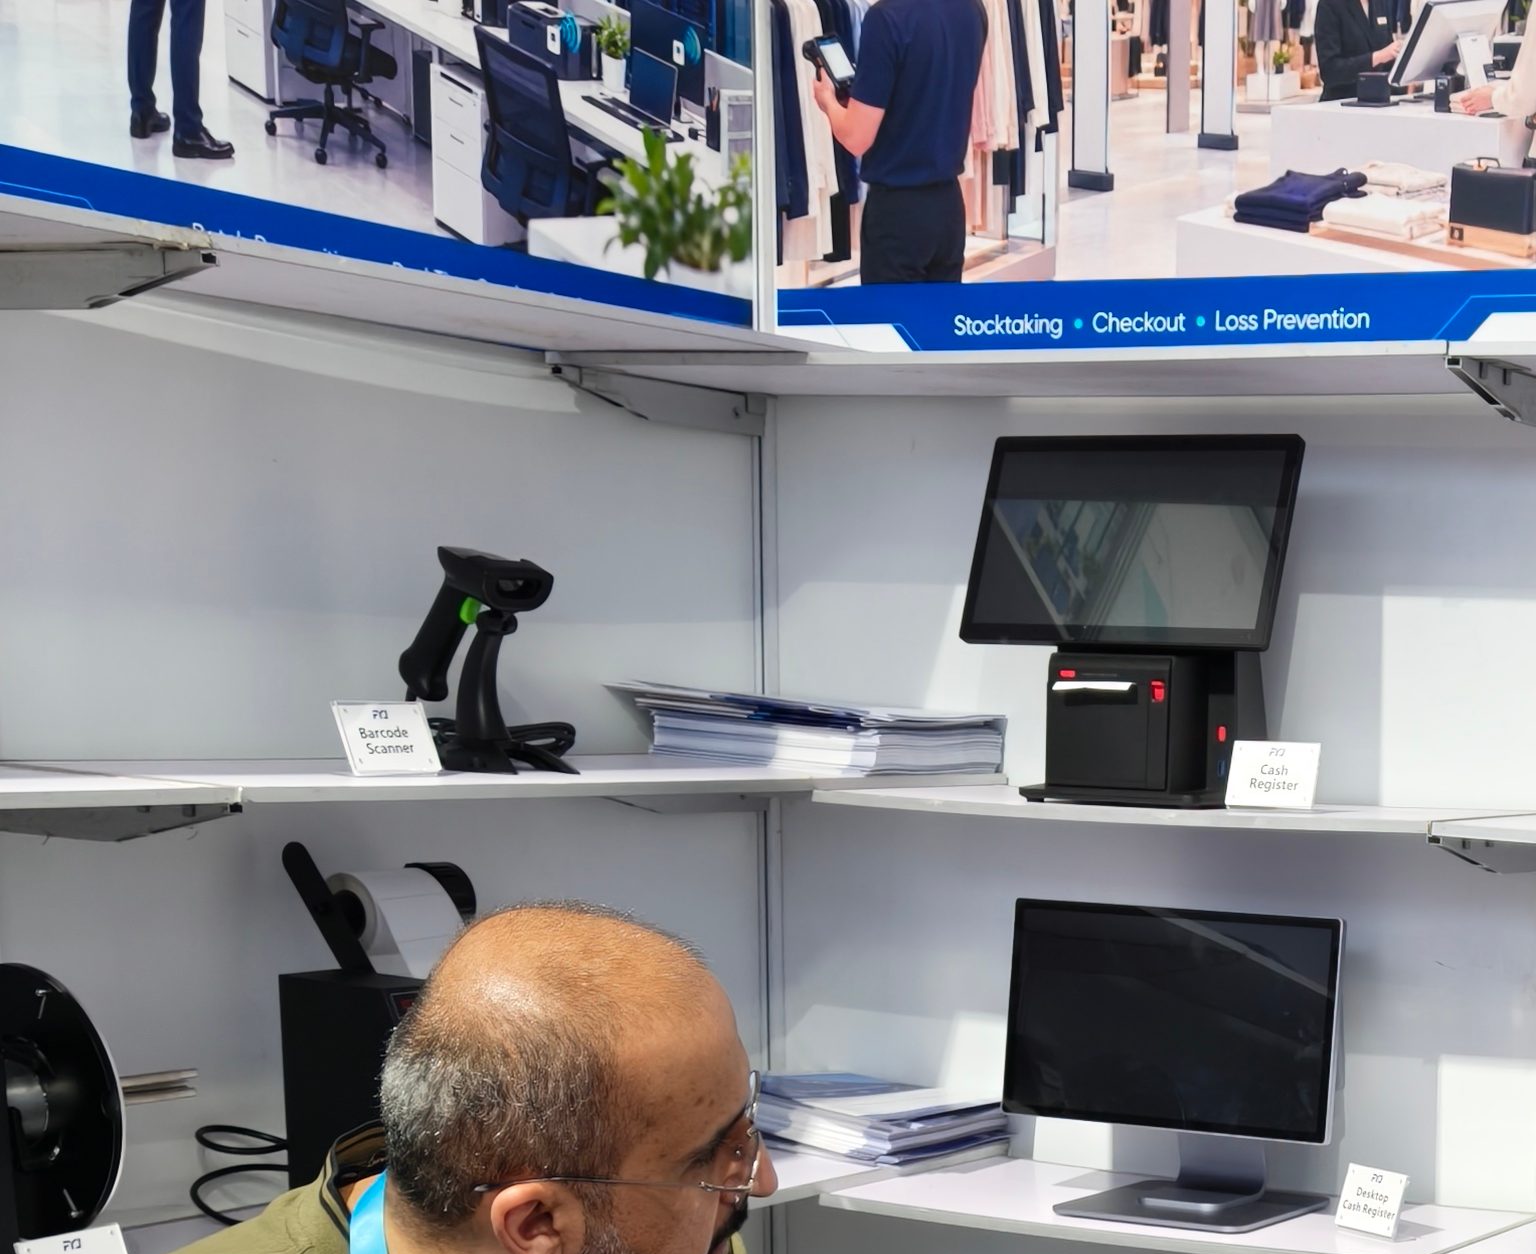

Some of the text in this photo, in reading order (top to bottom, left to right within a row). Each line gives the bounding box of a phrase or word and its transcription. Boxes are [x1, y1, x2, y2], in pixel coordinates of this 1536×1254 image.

[953, 307, 1370, 339] Stocktaking Checkout Loss Prevention
[359, 726, 409, 739] Barcode
[366, 743, 414, 755] Scanner
[1260, 764, 1288, 776] Cash
[1249, 778, 1299, 793] Register
[1356, 1186, 1389, 1204] Desktop
[1342, 1199, 1396, 1220] Cash Register
